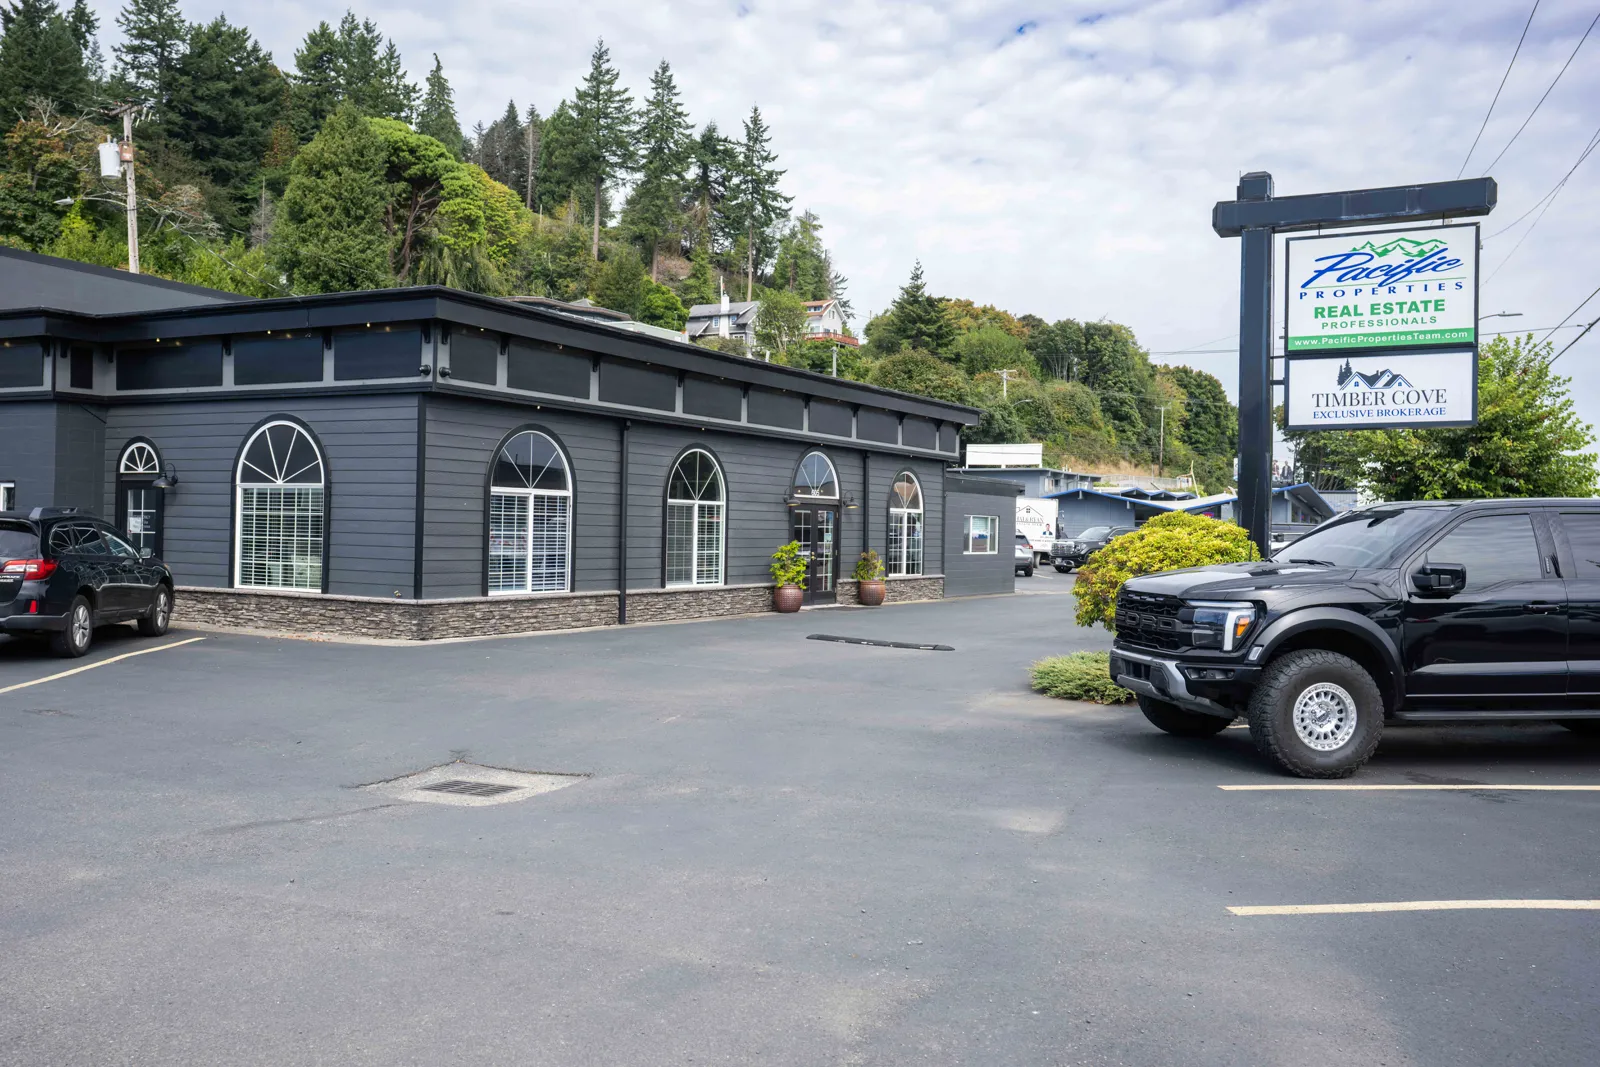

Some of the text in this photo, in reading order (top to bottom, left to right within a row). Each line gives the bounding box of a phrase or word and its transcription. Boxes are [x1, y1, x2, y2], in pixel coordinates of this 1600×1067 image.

[1301, 247, 1464, 288] Pacific
[1299, 281, 1464, 300] PROPERTIES
[1314, 299, 1446, 319] REAL ESTATE
[1321, 316, 1438, 330] PROFESSIONALS
[1294, 331, 1468, 346] www.PacificPropertiesTeam.com
[1311, 388, 1448, 408] TIMBER COVE
[1312, 406, 1447, 420] EXCLUSIVE BROKERAGE
